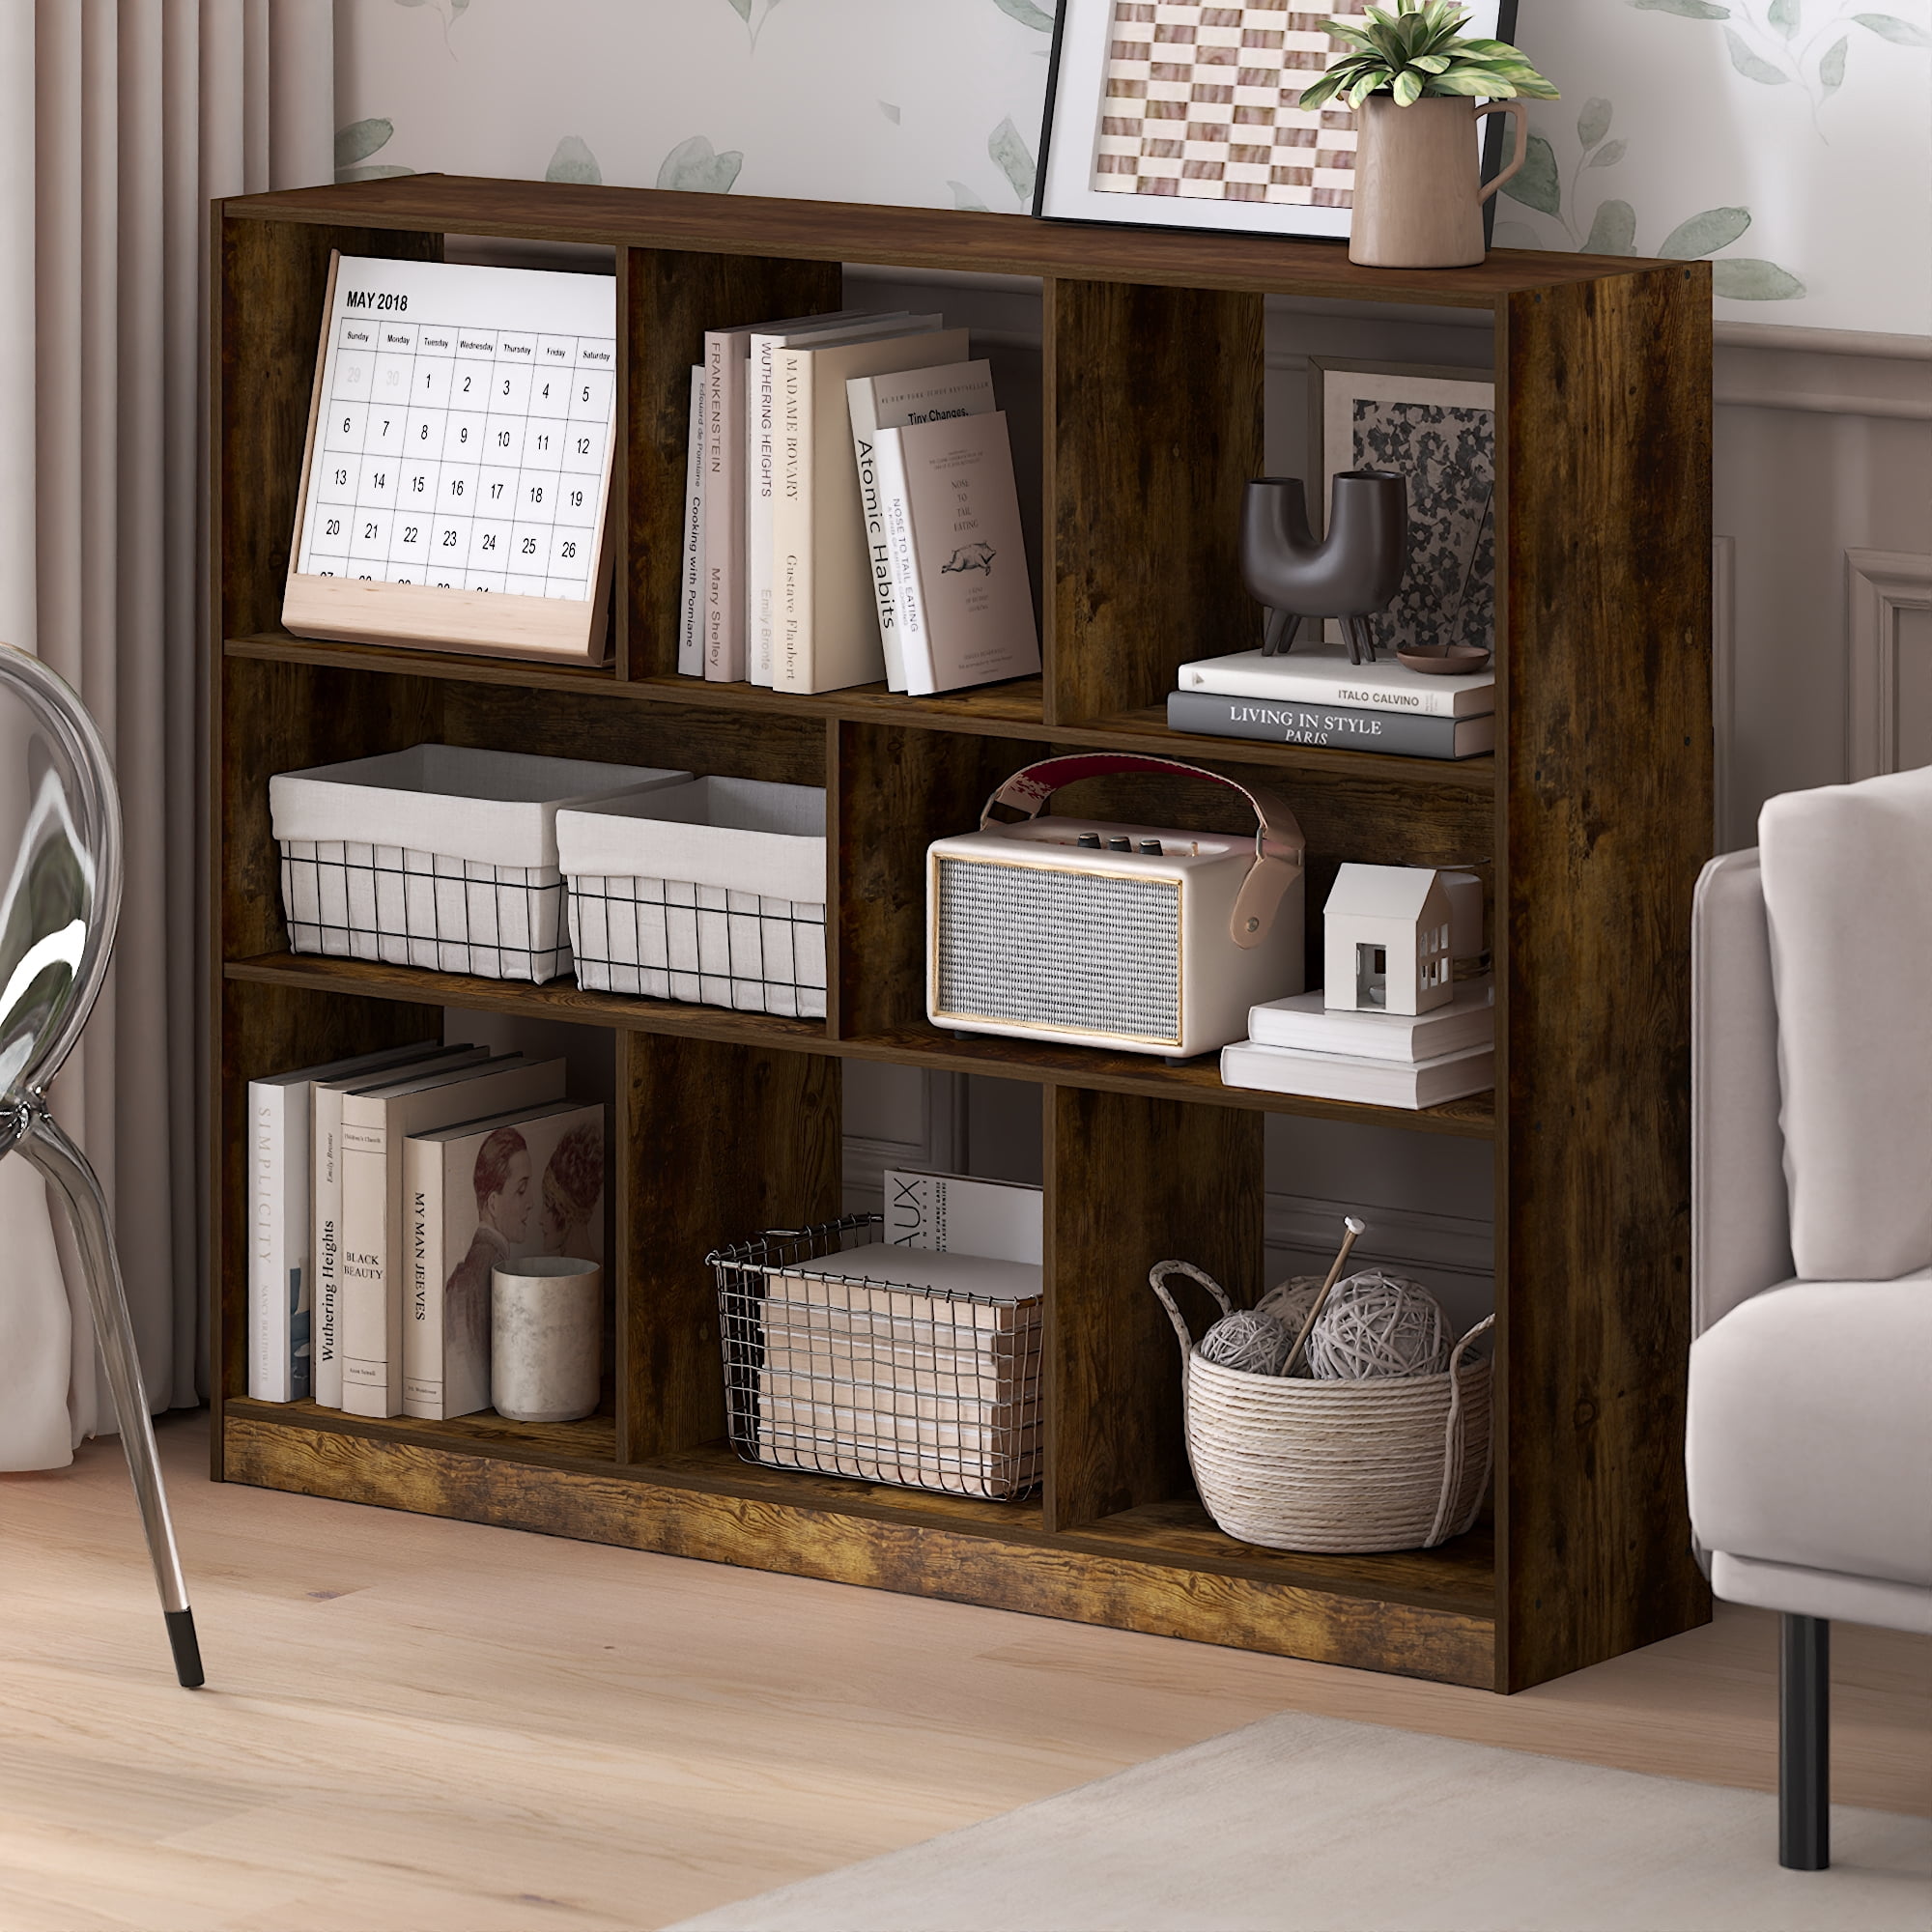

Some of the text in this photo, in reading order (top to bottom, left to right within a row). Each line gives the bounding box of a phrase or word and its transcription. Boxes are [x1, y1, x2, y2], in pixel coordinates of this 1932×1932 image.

[347, 291, 408, 311] MAY 2018
[348, 331, 611, 361] Sunday Monday Tuesday Wednesday Thursday Friday Saturday
[348, 367, 589, 402] 29 30 1 2 3 4 5
[711, 342, 721, 473] FRANKENSTEIN
[761, 342, 772, 497] WUTHERING HEIGHTS
[343, 418, 589, 454] 6 7 8 9 10 11 12
[697, 430, 703, 440] de
[786, 358, 797, 501] MADAME BOVARY
[334, 469, 582, 506] 13 14 15 16 17 18 19
[327, 520, 576, 557] 20 21 22 23 24 25 26
[690, 497, 700, 553] Cooking
[857, 439, 895, 629] Atomic Habits
[894, 498, 918, 633] NOSE TO TAIL EATING
[711, 567, 721, 668] Mary Shelley
[761, 588, 772, 624] Emily
[786, 554, 797, 680] Gustave Flaubert
[1338, 690, 1369, 701] ITALO
[1373, 693, 1419, 706] CALVINO
[1231, 706, 1381, 734] LIVING IN STYLE
[1286, 730, 1327, 745] PARIS
[258, 1106, 270, 1264] SIMPLICITY
[344, 1265, 384, 1279] BEAUTY
[347, 1252, 379, 1264] BLACK
[415, 1192, 425, 1321] MY MAN JEEVES
[323, 1220, 337, 1361] Wuthering Heights
